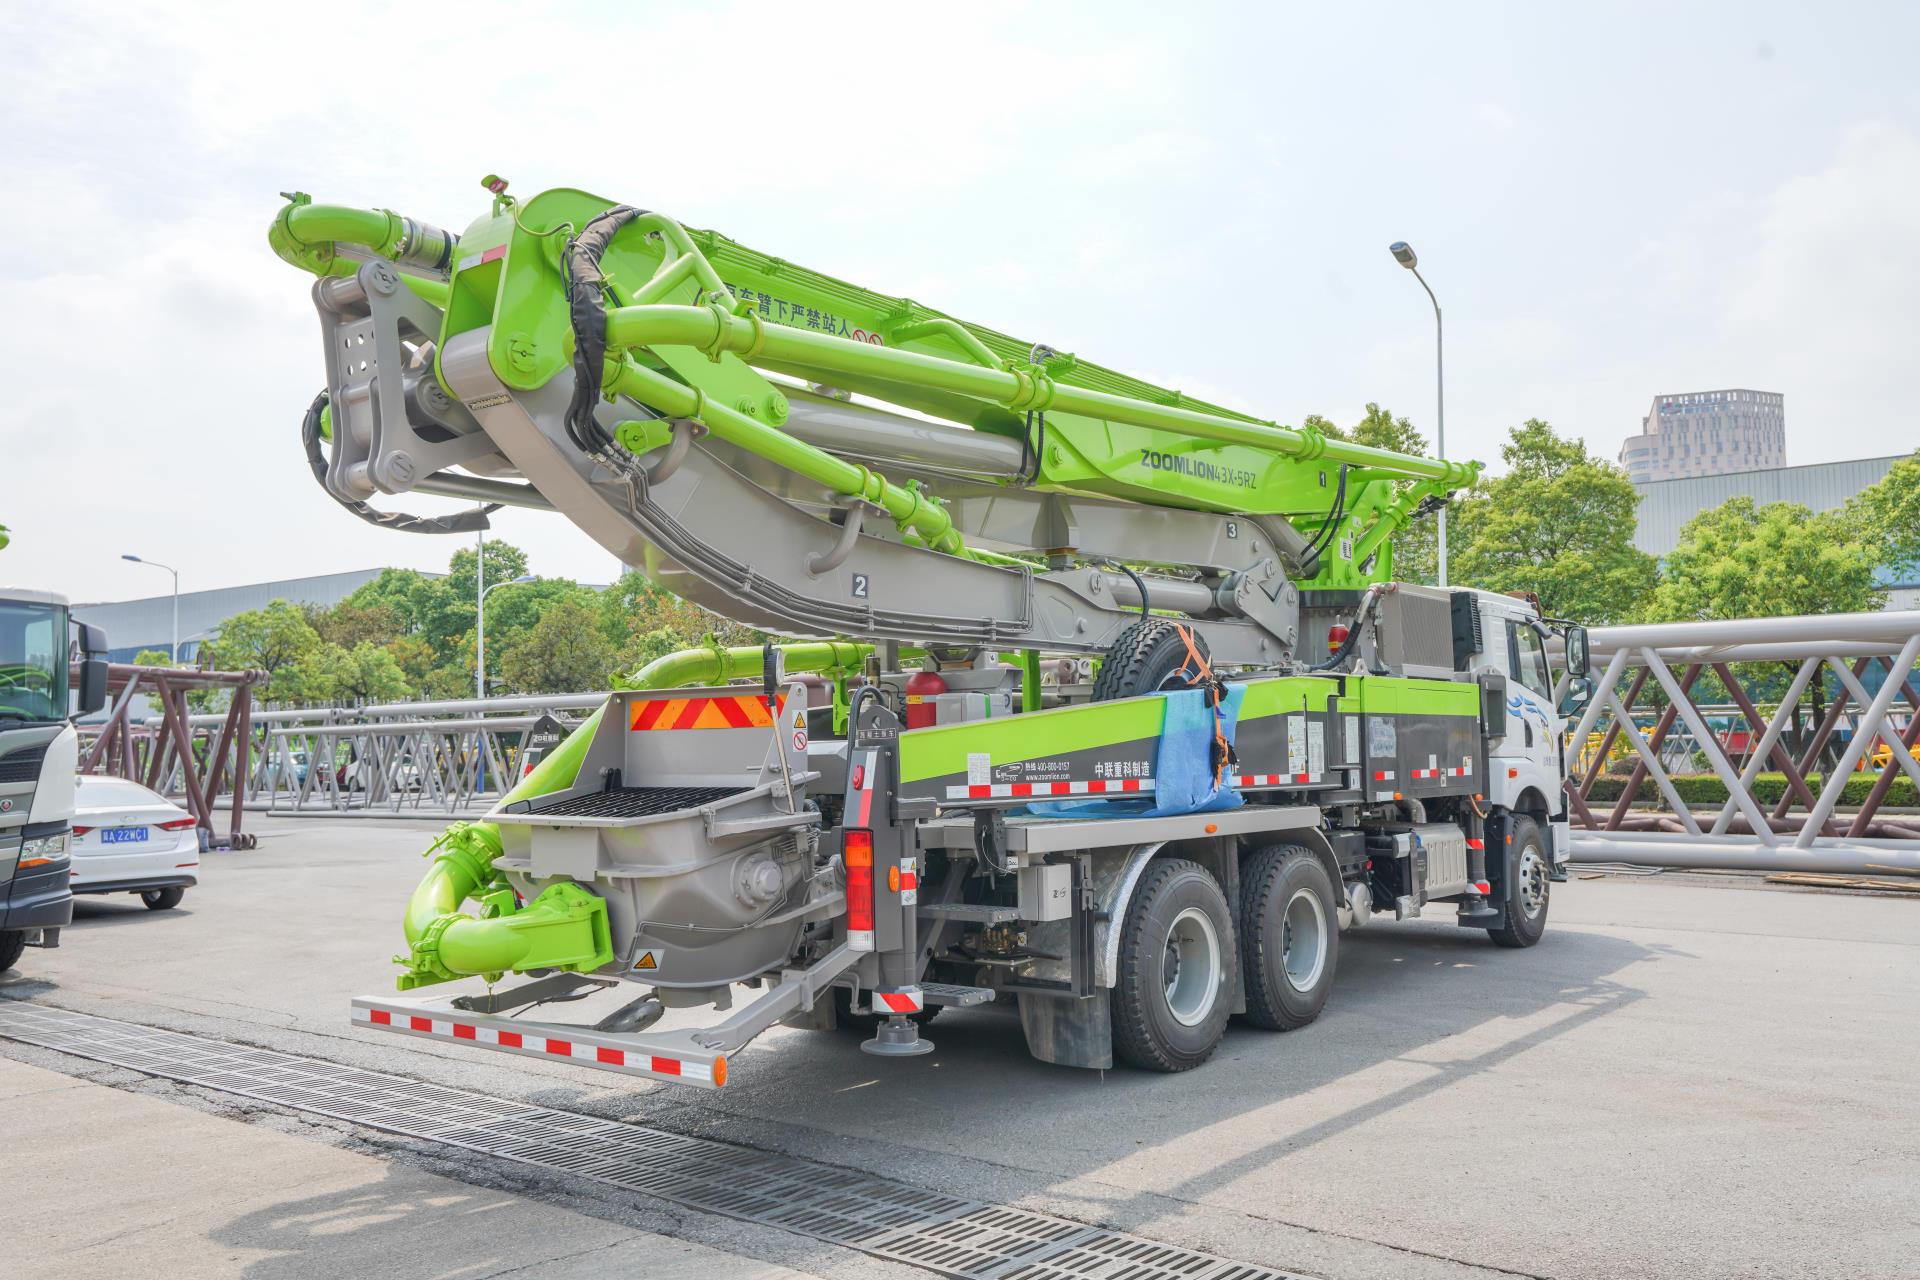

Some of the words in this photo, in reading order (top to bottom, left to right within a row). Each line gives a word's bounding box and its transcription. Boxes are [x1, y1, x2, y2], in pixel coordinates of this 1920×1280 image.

[1228, 523, 1237, 538] 3
[855, 575, 866, 596] 2
[1094, 760, 1150, 779] 中联重科制造
